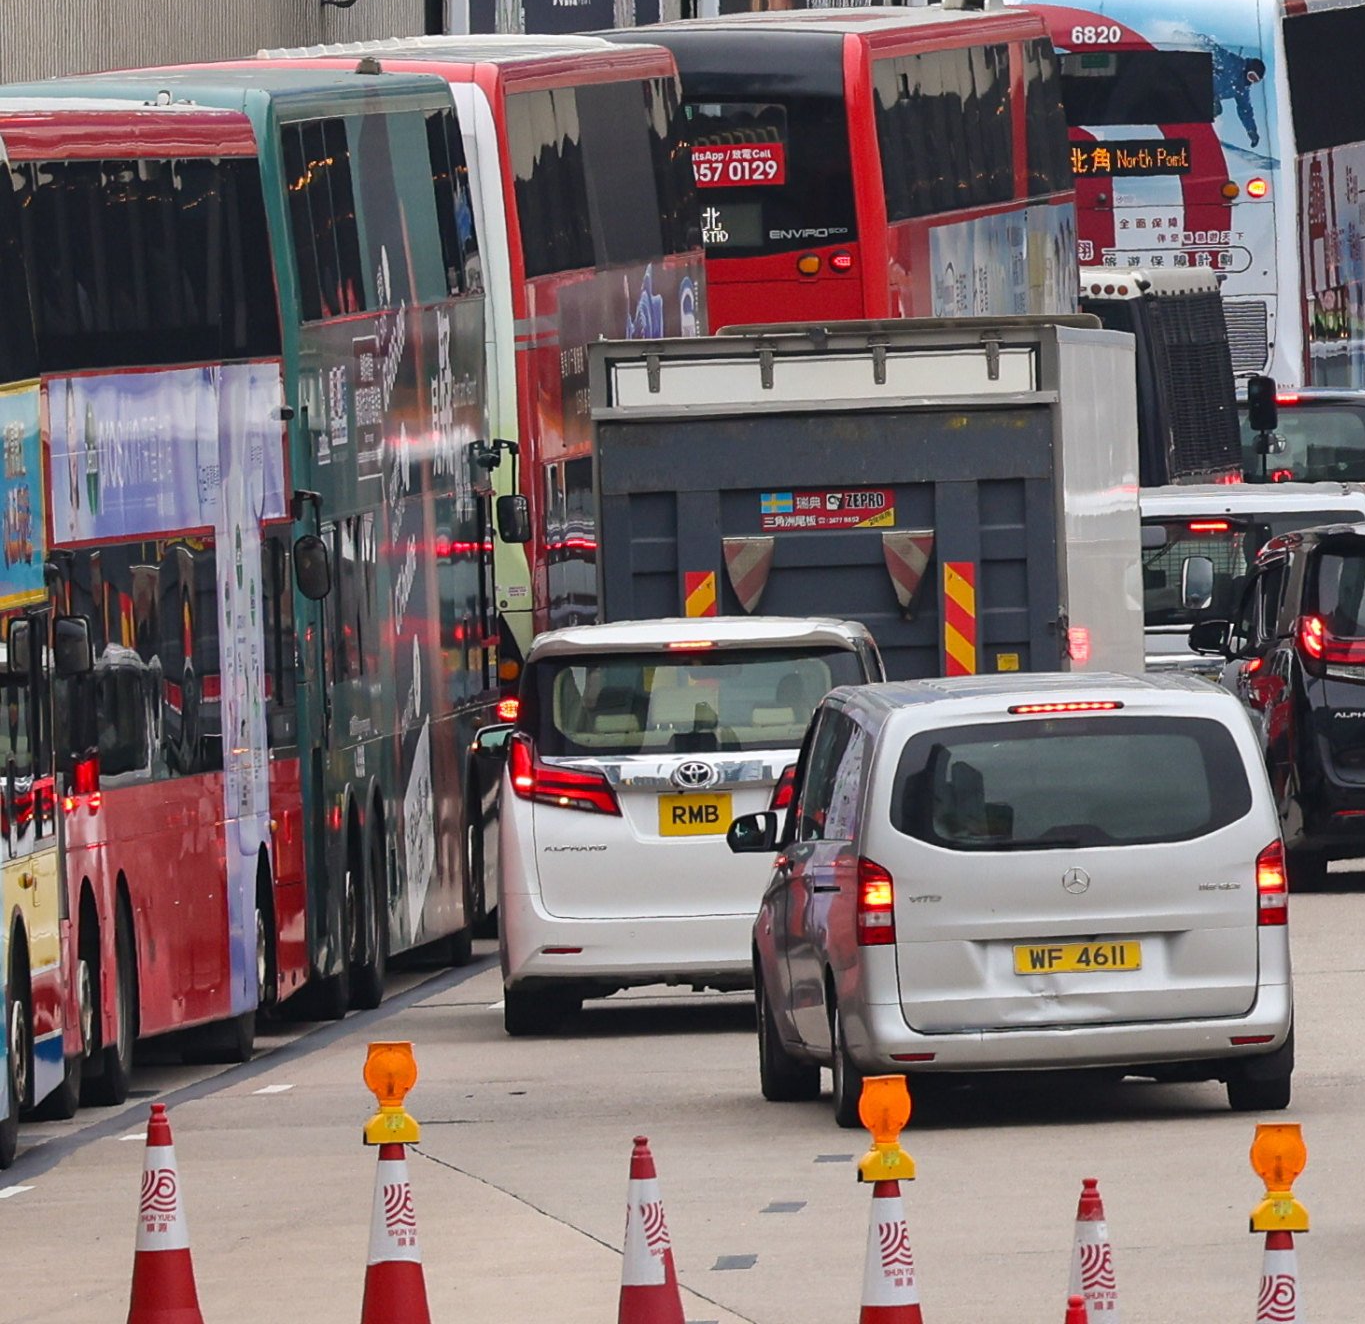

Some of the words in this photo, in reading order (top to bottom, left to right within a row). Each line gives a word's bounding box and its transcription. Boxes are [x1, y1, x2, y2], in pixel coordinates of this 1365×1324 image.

[1071, 25, 1121, 44] 6820
[729, 160, 778, 181] 0129
[1070, 147, 1111, 173] 北角
[1116, 148, 1153, 168] North
[1157, 147, 1189, 167] Point
[702, 206, 721, 231] 北
[845, 491, 886, 509] ZEPRO
[672, 804, 720, 825] RMB
[1029, 947, 1063, 969] WF
[1075, 944, 1126, 967] 4611
